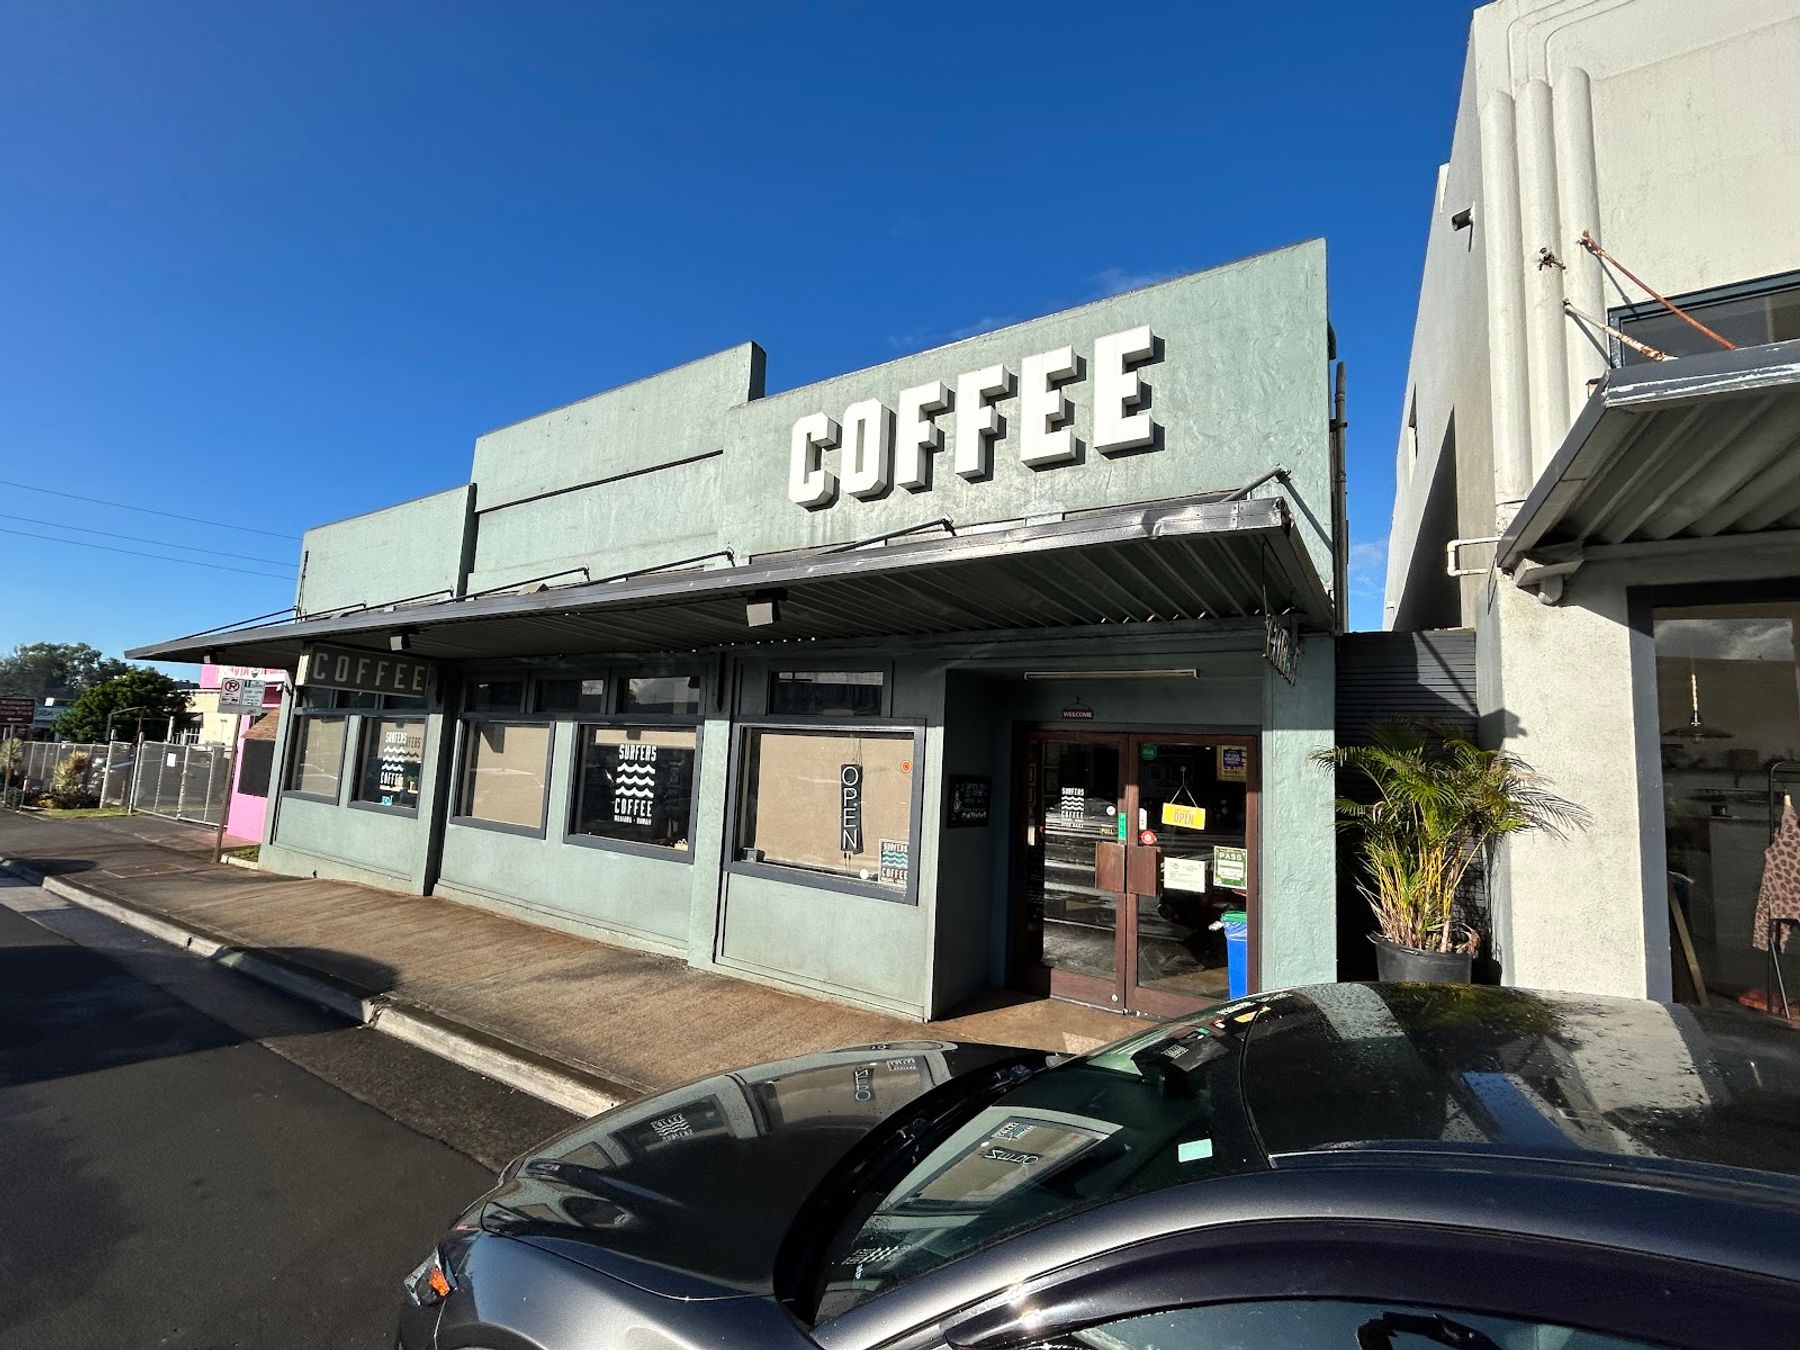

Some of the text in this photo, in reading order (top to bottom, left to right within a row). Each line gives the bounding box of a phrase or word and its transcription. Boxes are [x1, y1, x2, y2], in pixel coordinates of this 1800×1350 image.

[788, 324, 1156, 505] COFFEE
[312, 652, 425, 691] COFFEE
[619, 743, 657, 762] SURFERS
[614, 798, 653, 817] COFFEE
[841, 766, 859, 850] OPEN
[1173, 812, 1194, 825] OPEN
[1220, 851, 1242, 860] PASS
